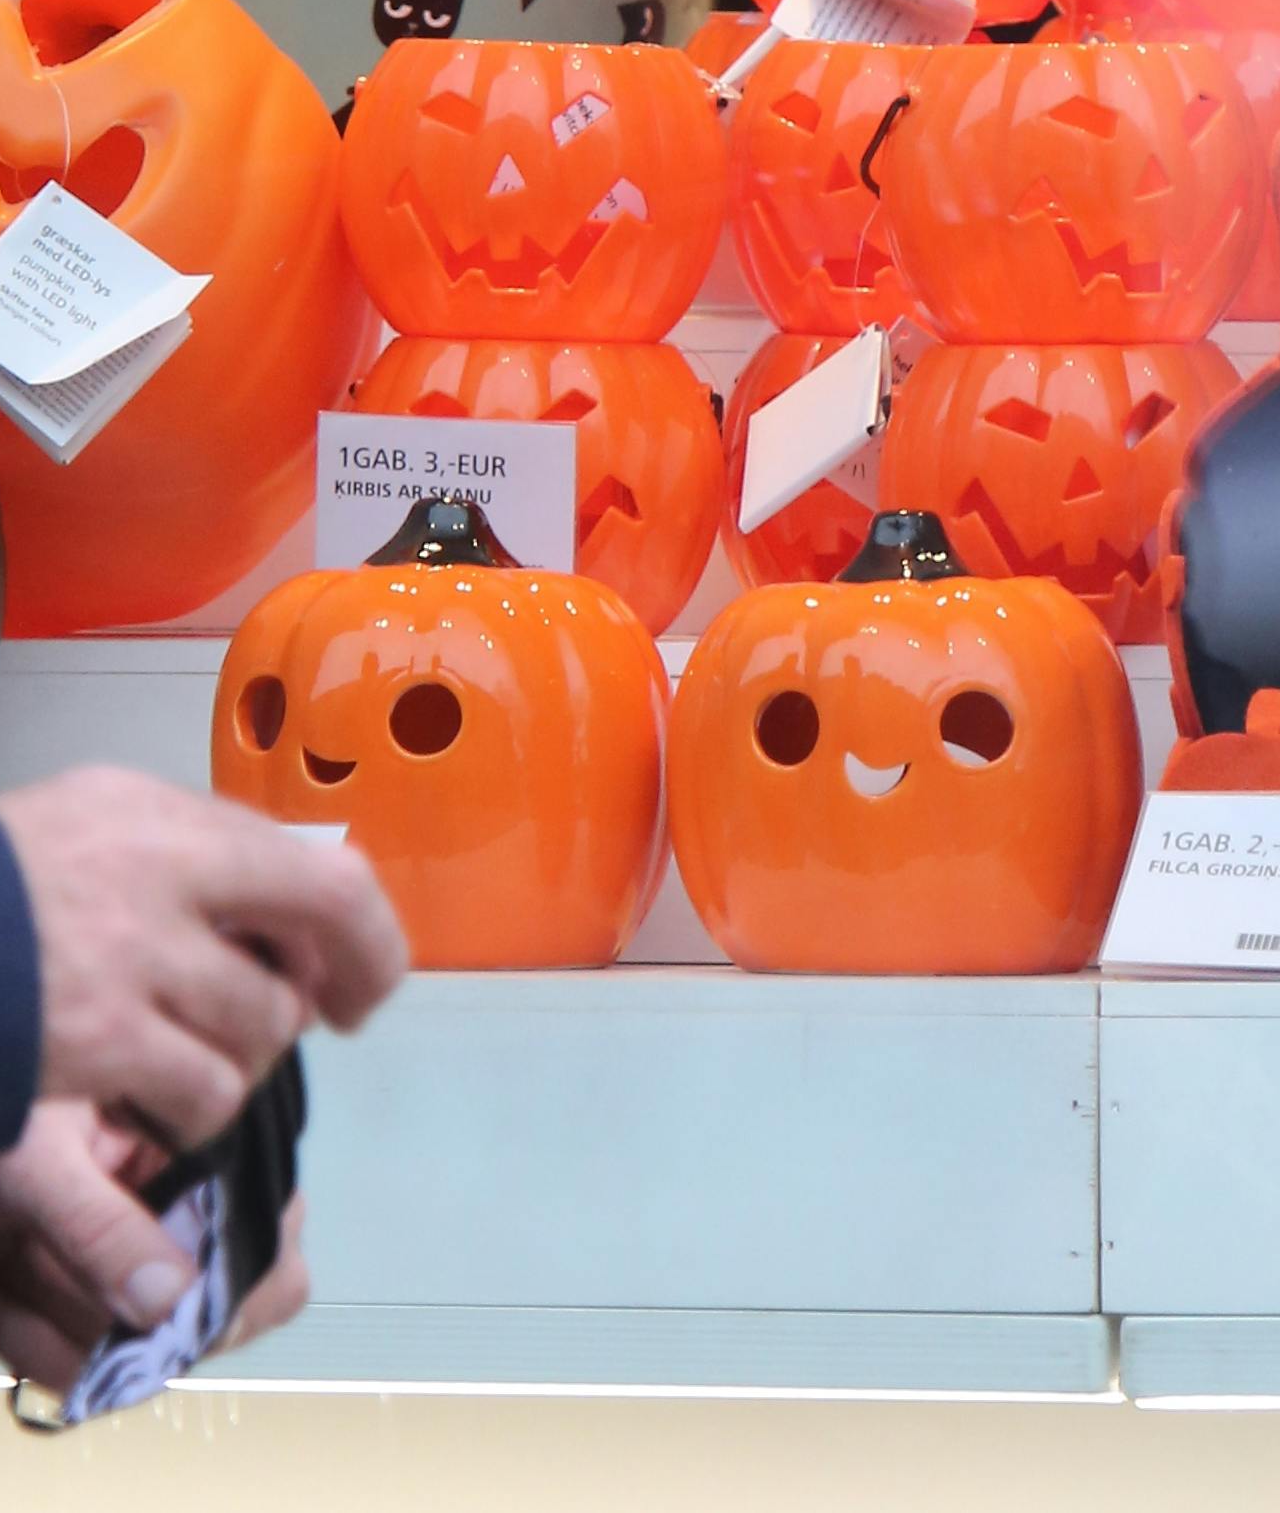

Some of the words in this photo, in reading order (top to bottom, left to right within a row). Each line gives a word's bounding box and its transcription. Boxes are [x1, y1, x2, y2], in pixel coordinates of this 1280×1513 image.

[41, 224, 97, 266] græskar
[19, 254, 76, 295] pumpkin
[31, 236, 63, 263] med
[64, 257, 112, 299] LED-lys
[11, 267, 41, 292] with
[40, 285, 66, 310] LED
[67, 304, 98, 332] light
[339, 446, 414, 473] 1GAB.
[424, 451, 506, 478] 3,-EUR
[334, 480, 391, 499] ĶIRBIS
[398, 484, 422, 499] AR
[1161, 831, 1236, 854] 1GAB.
[1148, 860, 1200, 875] FILCA
